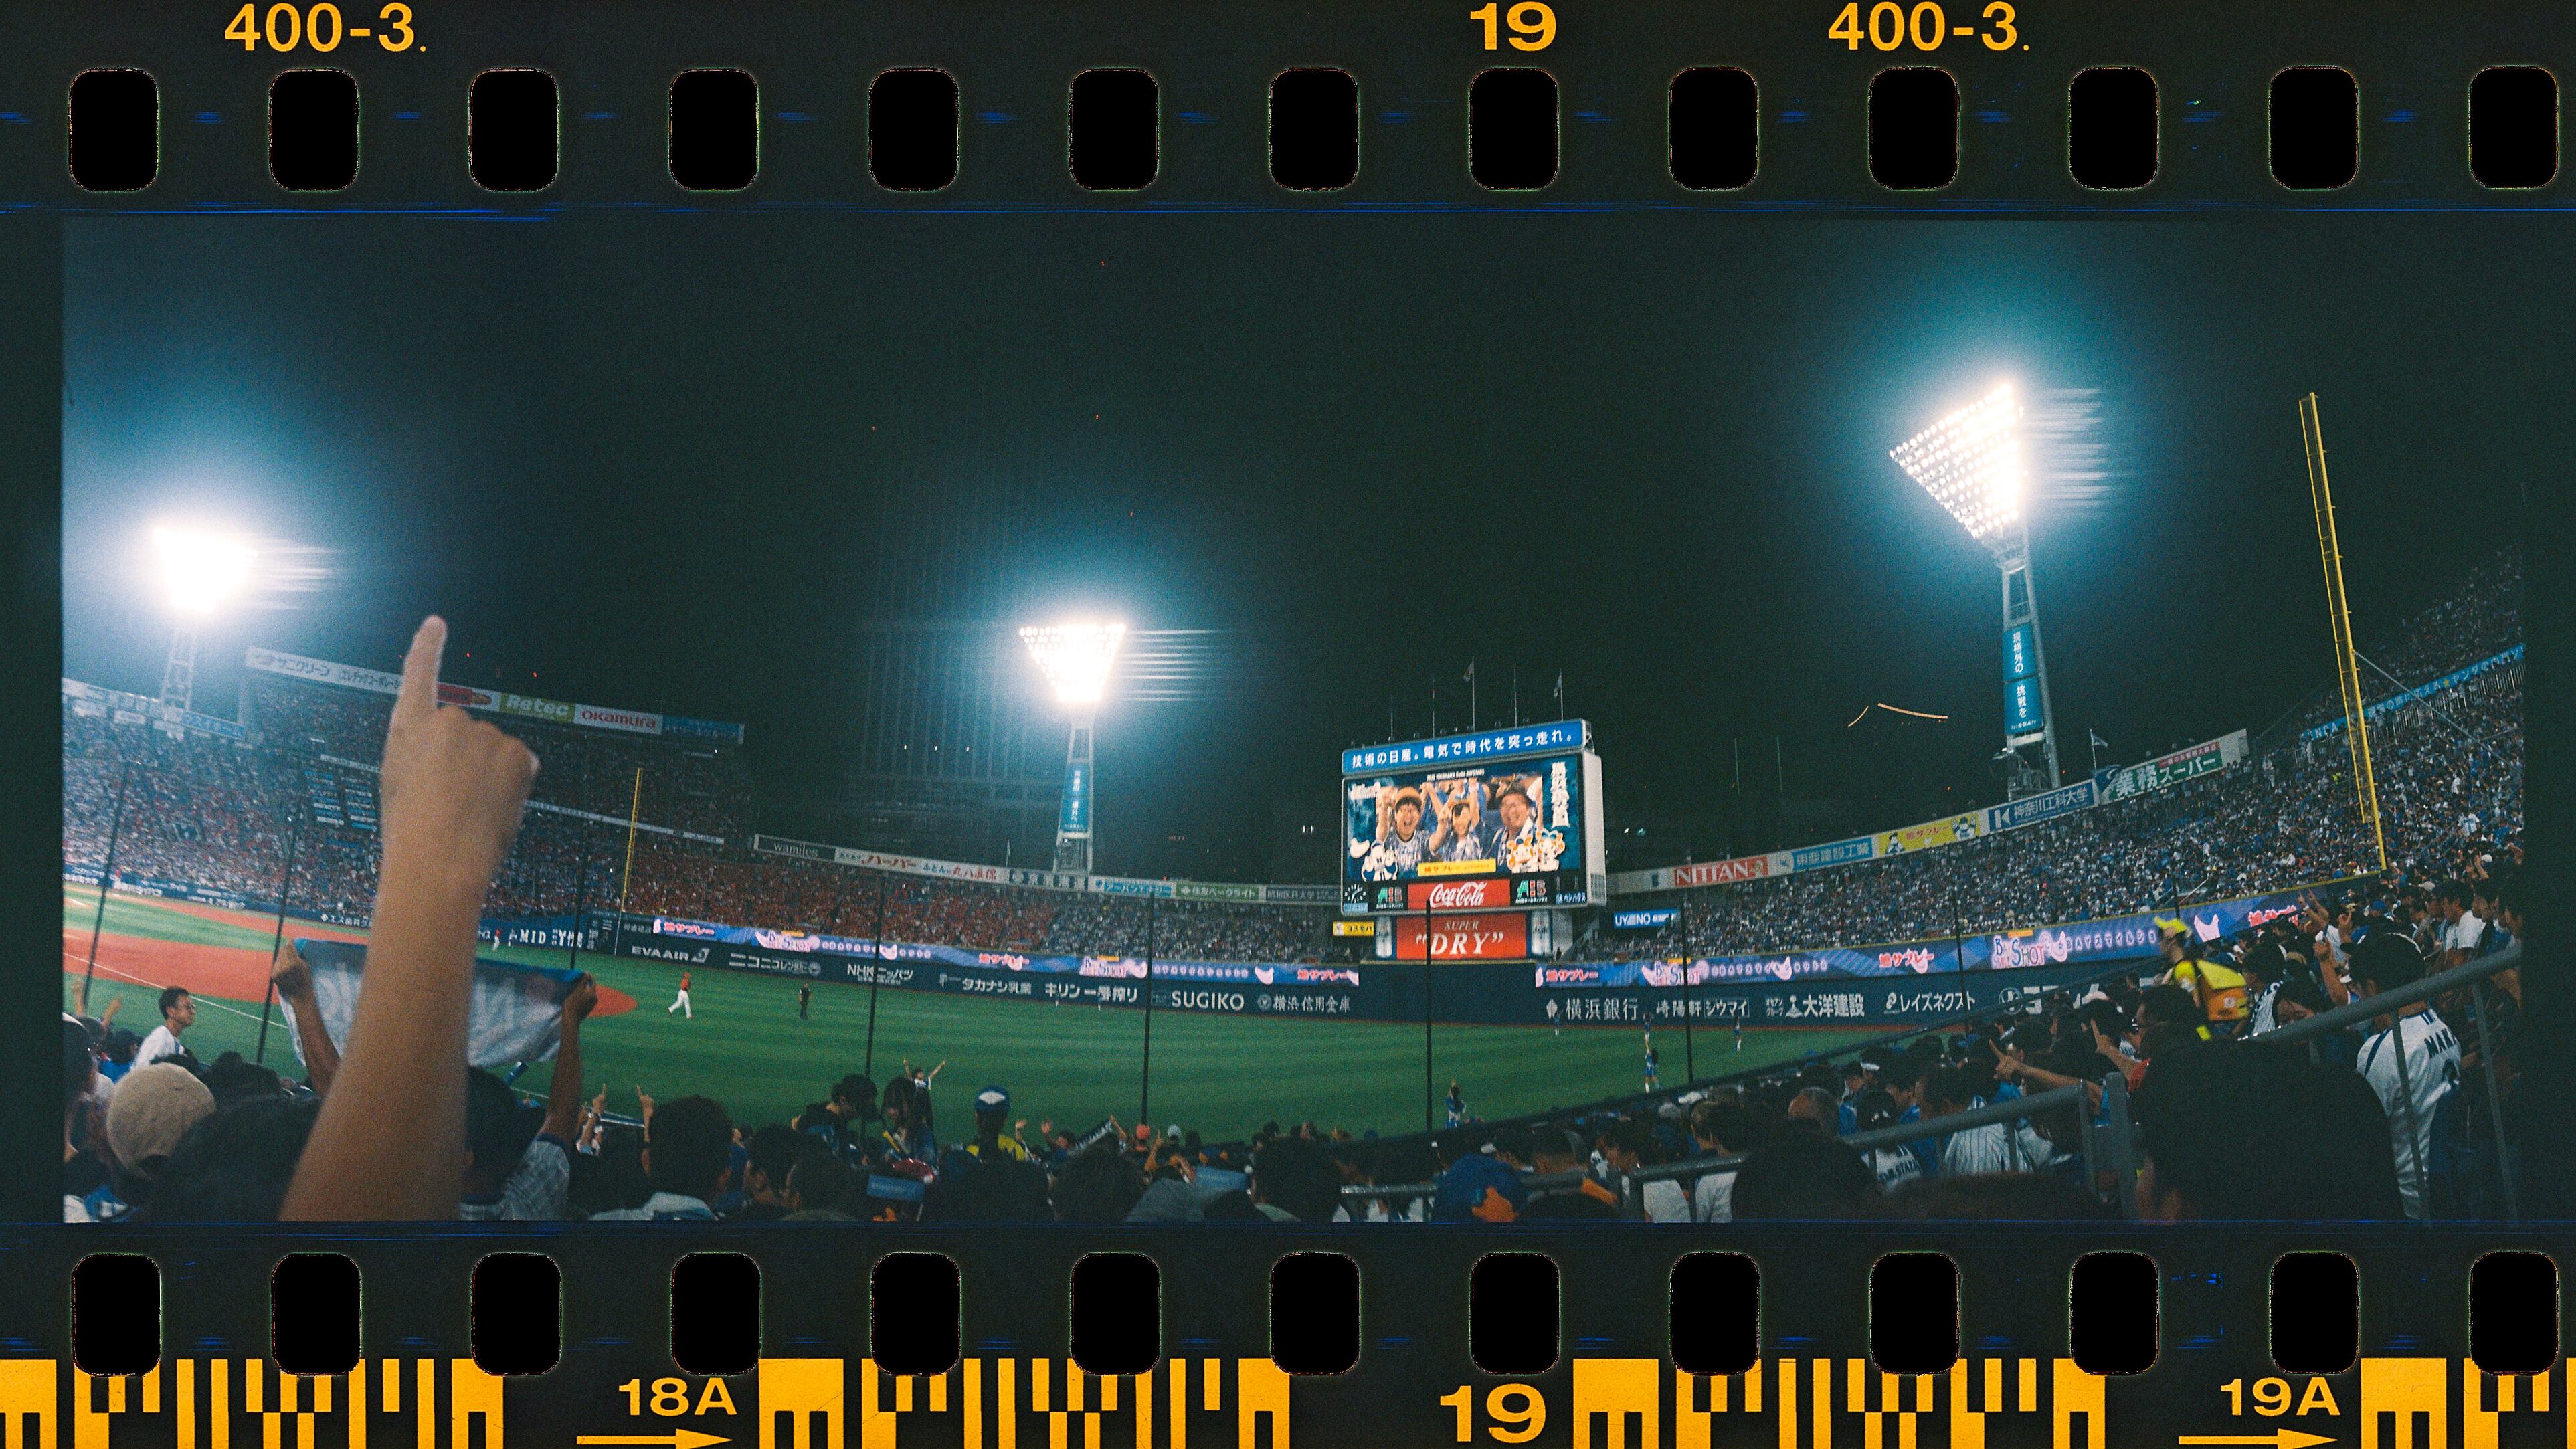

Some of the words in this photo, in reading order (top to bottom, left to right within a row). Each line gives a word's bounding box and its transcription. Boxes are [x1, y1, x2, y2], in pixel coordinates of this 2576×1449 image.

[1470, 2, 1556, 51] 19
[2116, 757, 2216, 797] 業務スーパー
[2014, 788, 2088, 819] 神奈川工科大学
[774, 844, 818, 857] wamiles
[1677, 862, 1748, 886] NITTAN
[961, 977, 1032, 995] タカナシ乳業
[1044, 982, 1080, 998] キリン
[1083, 985, 1139, 1003] 一番搾り
[1172, 990, 1245, 1011] SUGIKO
[1273, 993, 1351, 1013] 横浜信用金庫
[1566, 998, 1639, 1021] 横浜銀行
[1656, 999, 1702, 1019] 崎陽軒
[1706, 1000, 1750, 1018] シウマイ
[1803, 993, 1865, 1018] 大洋建設
[1900, 991, 1975, 1013] レイズネクスト
[618, 1377, 737, 1416] 18A
[2221, 1377, 2340, 1416] 19A
[1440, 1383, 1546, 1444] 19
